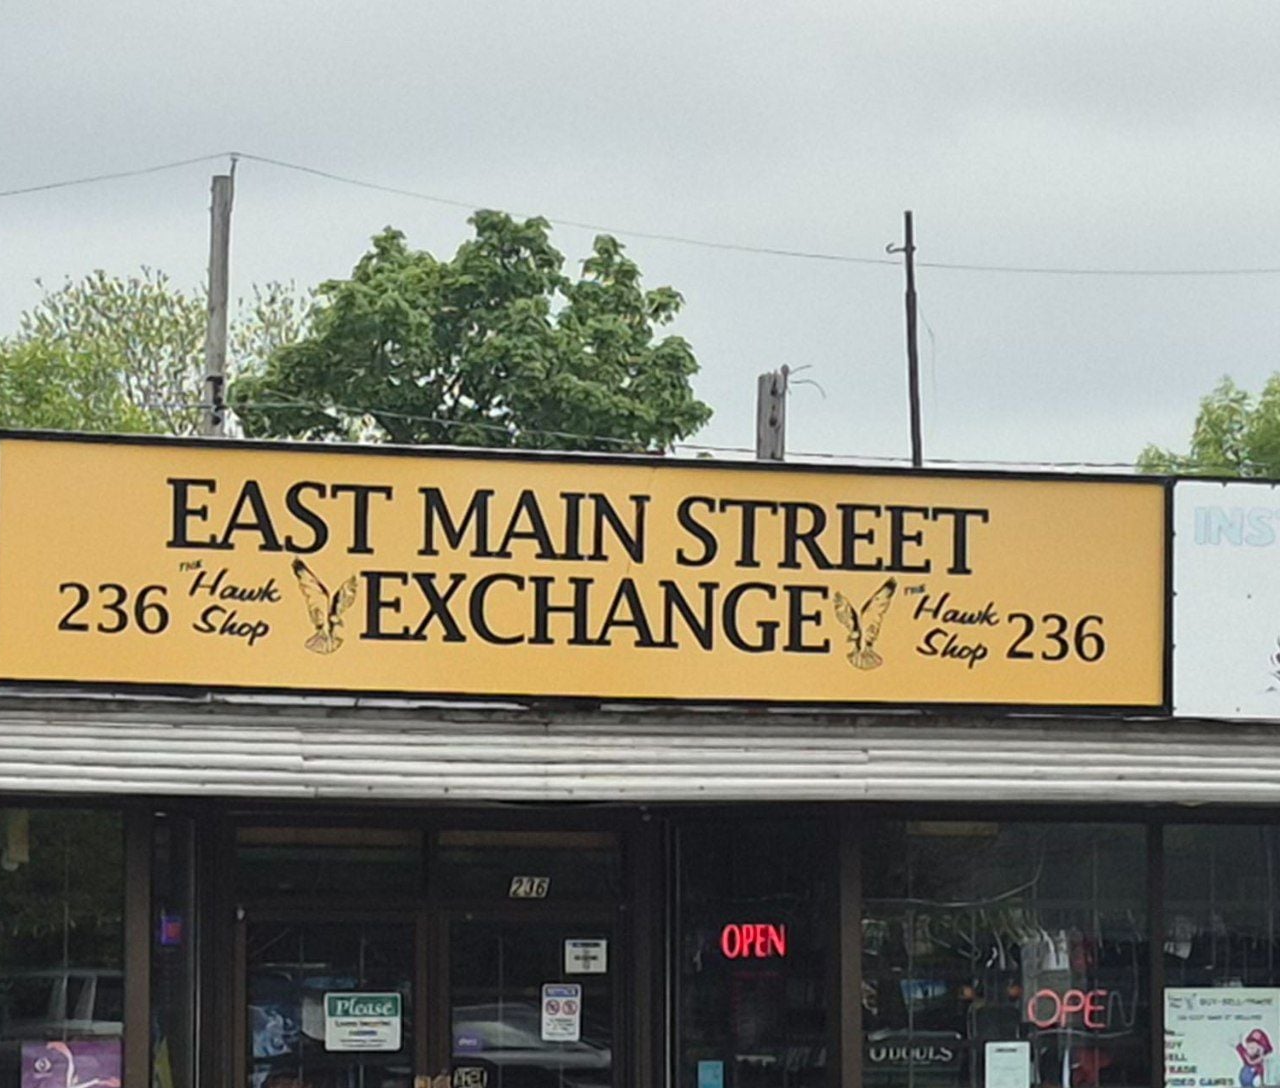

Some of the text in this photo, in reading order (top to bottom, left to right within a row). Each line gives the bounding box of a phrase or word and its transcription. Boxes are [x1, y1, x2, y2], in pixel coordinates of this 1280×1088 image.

[166, 477, 989, 575] EAST MAIN STREET
[188, 568, 282, 604] Hawk
[58, 582, 169, 634] 236
[192, 604, 270, 646] Shop
[360, 570, 830, 653] EXCHANGE
[913, 592, 999, 627] Hawk
[916, 628, 988, 669] Shop
[1006, 613, 1105, 662] 236
[722, 924, 787, 959] OPEN
[335, 997, 393, 1016] Please
